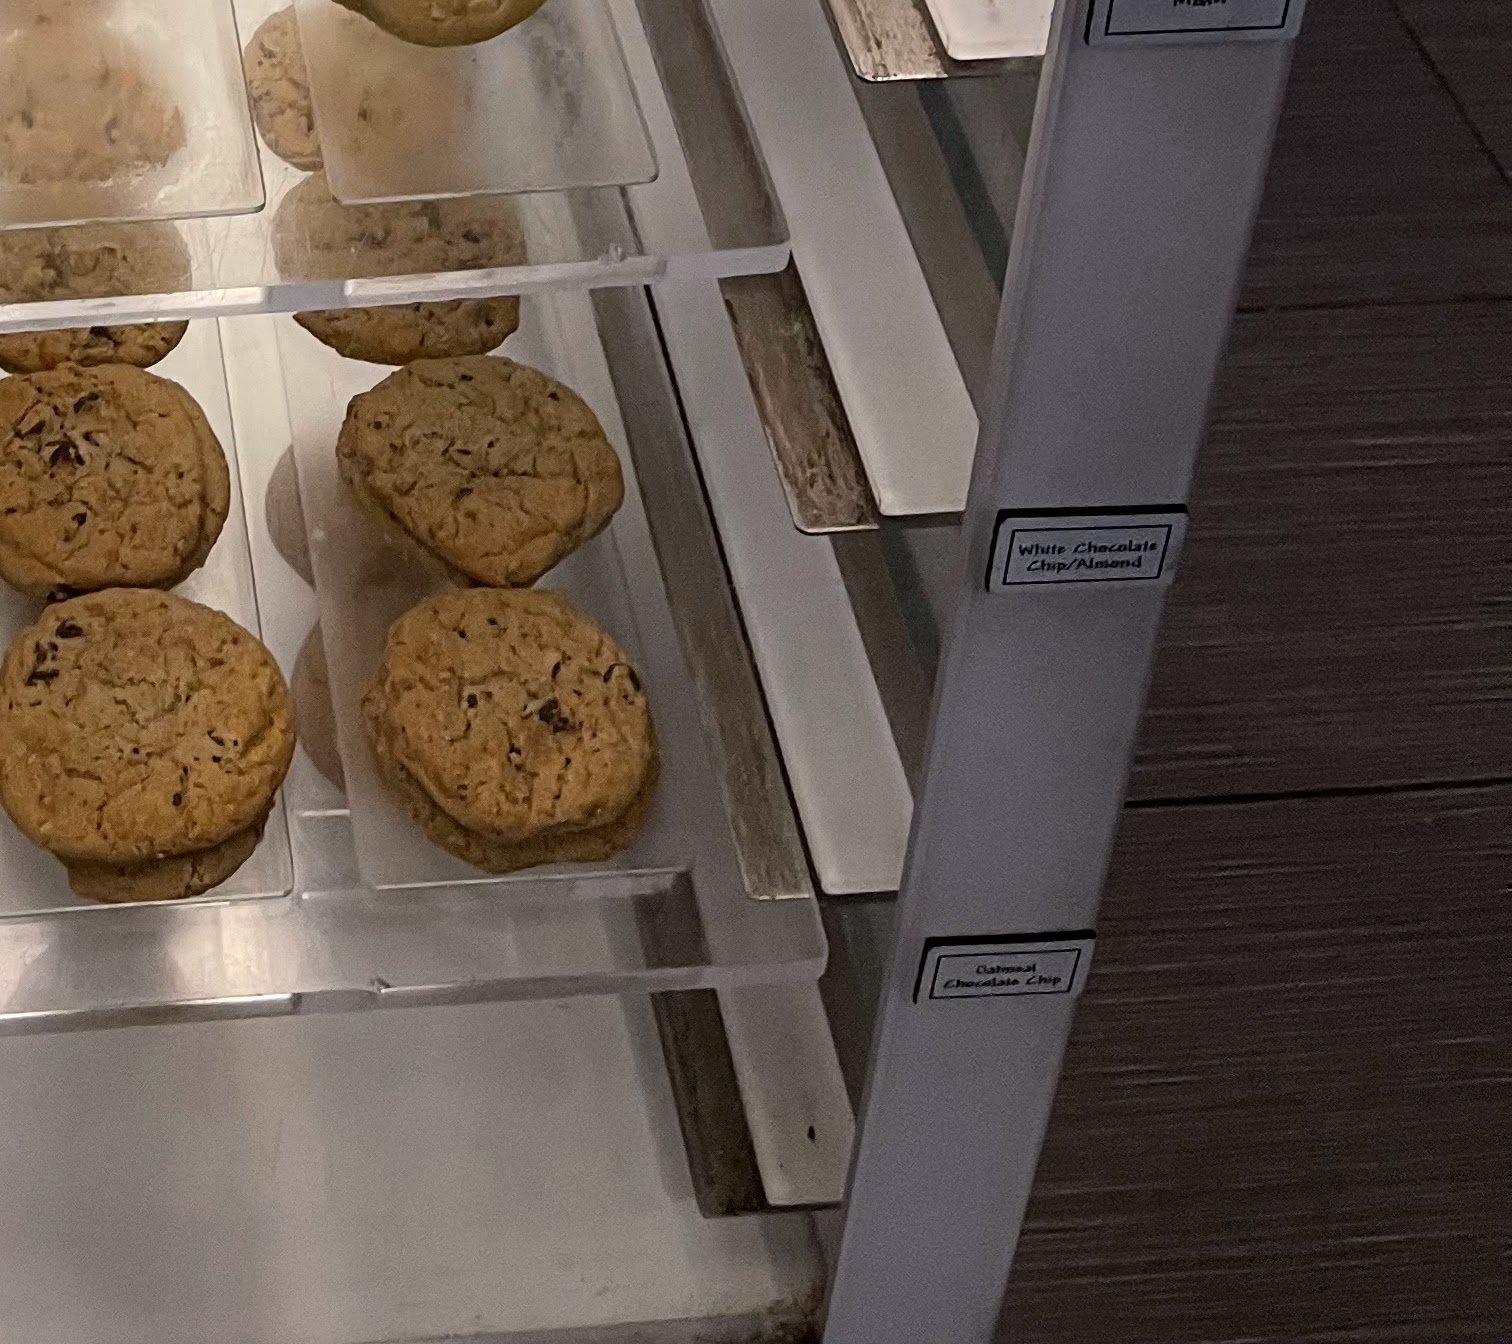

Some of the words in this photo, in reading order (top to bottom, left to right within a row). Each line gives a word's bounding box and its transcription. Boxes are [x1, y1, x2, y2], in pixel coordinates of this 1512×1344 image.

[1019, 543, 1066, 556] White
[1072, 539, 1157, 554] Chocolate
[1026, 555, 1143, 573] Chip/Almond
[976, 963, 1037, 975] Oatmeal
[943, 977, 1020, 989] Chocolate
[1025, 975, 1062, 987] Chip
